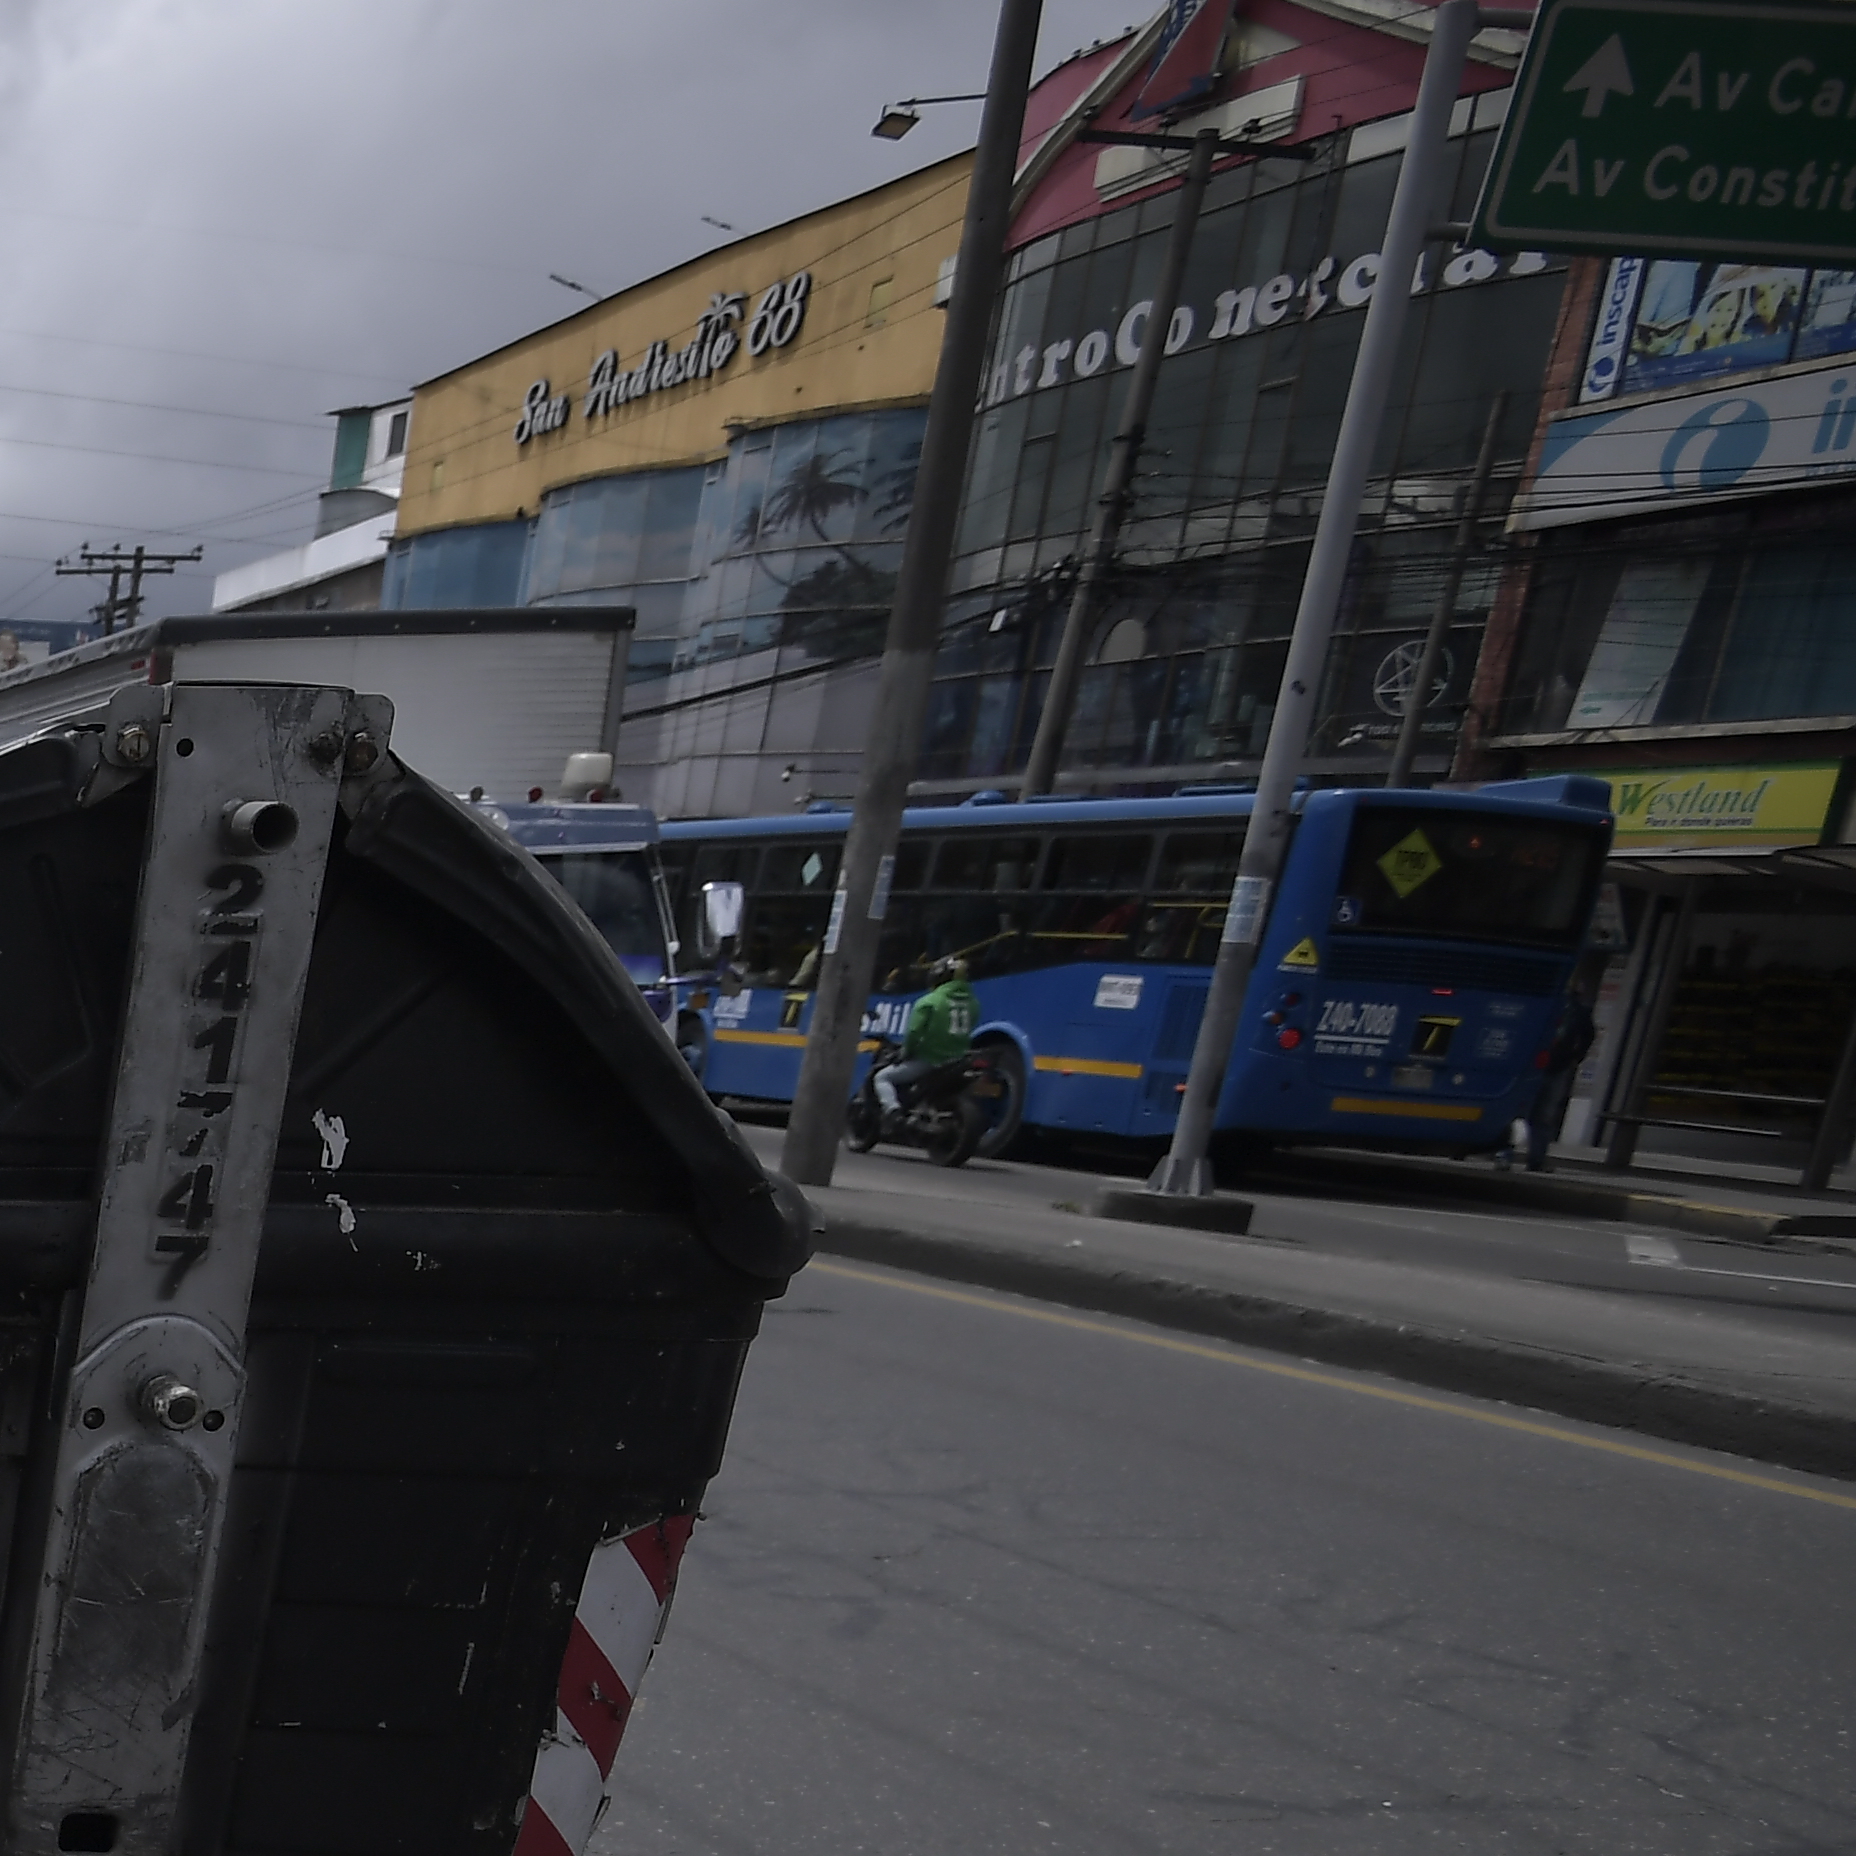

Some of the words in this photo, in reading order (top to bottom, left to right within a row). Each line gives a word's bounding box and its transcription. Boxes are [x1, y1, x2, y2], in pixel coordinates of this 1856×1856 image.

[1654, 51, 1751, 112] Av
[1532, 138, 1626, 198] Av
[515, 379, 568, 443] San
[747, 271, 811, 357] 68
[1619, 778, 1771, 815] Westland
